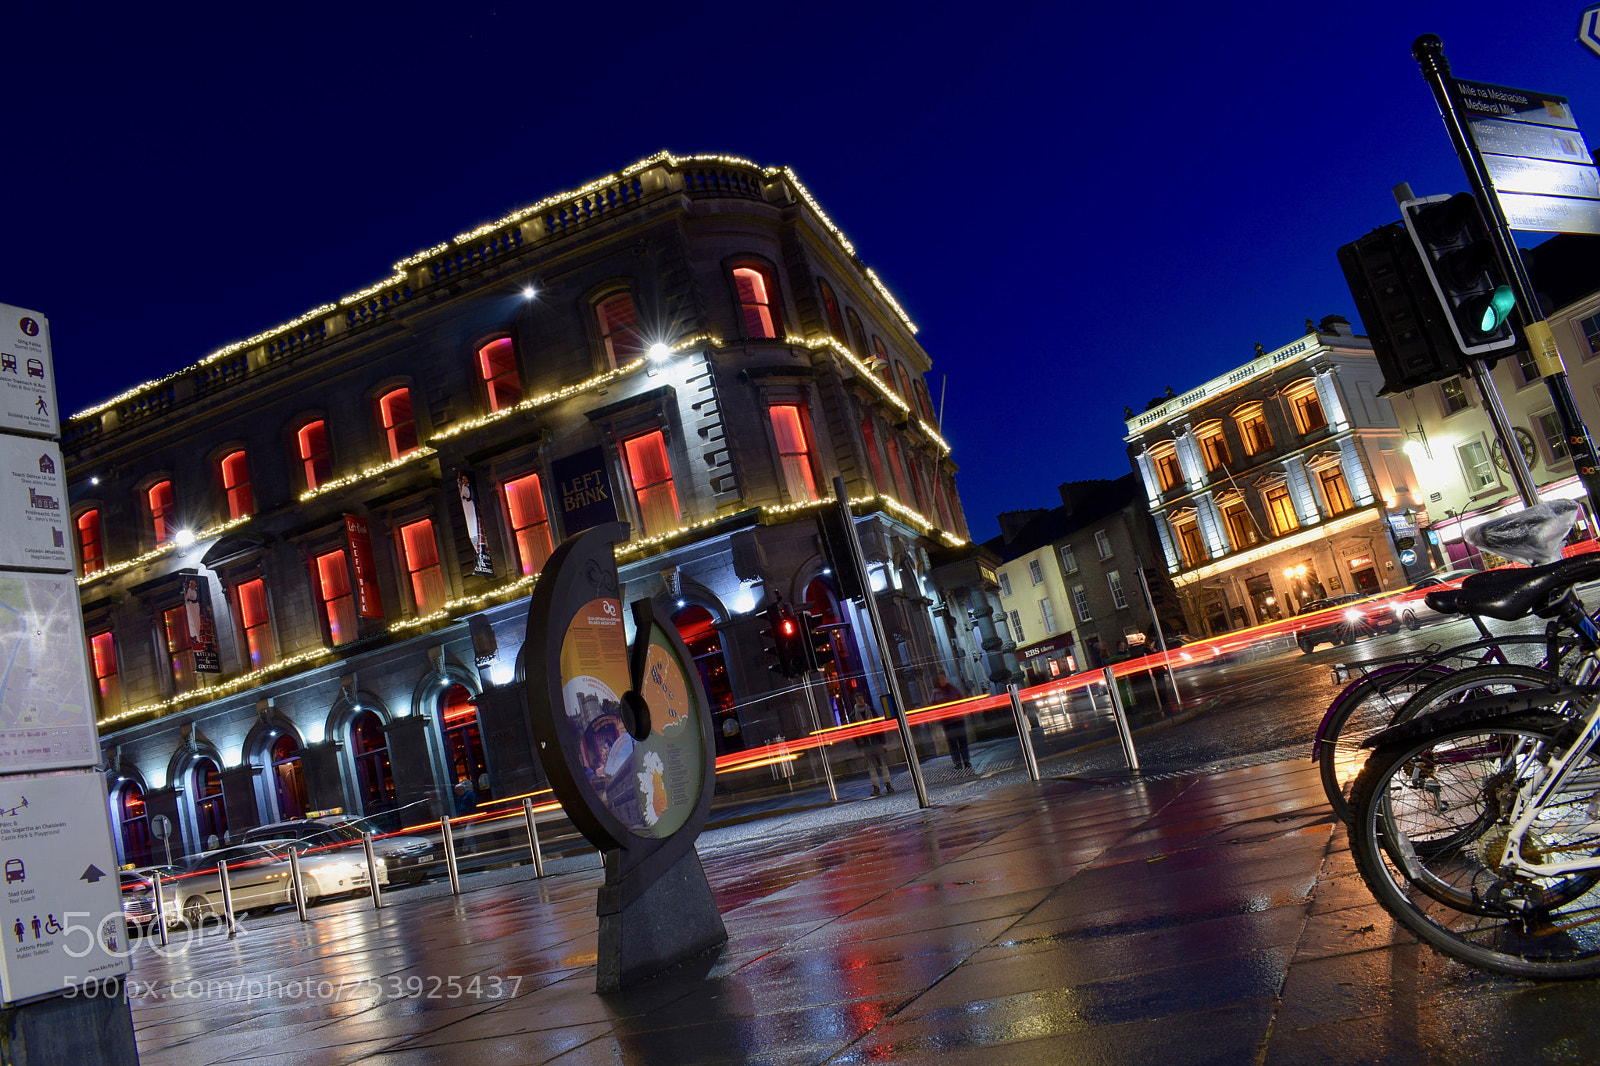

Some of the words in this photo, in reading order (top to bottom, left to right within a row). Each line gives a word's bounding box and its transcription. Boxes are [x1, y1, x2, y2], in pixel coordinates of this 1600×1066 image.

[1464, 98, 1500, 114] Medieval
[561, 469, 602, 497] LEFT
[563, 484, 609, 513] BANK
[352, 541, 361, 574] LEFT
